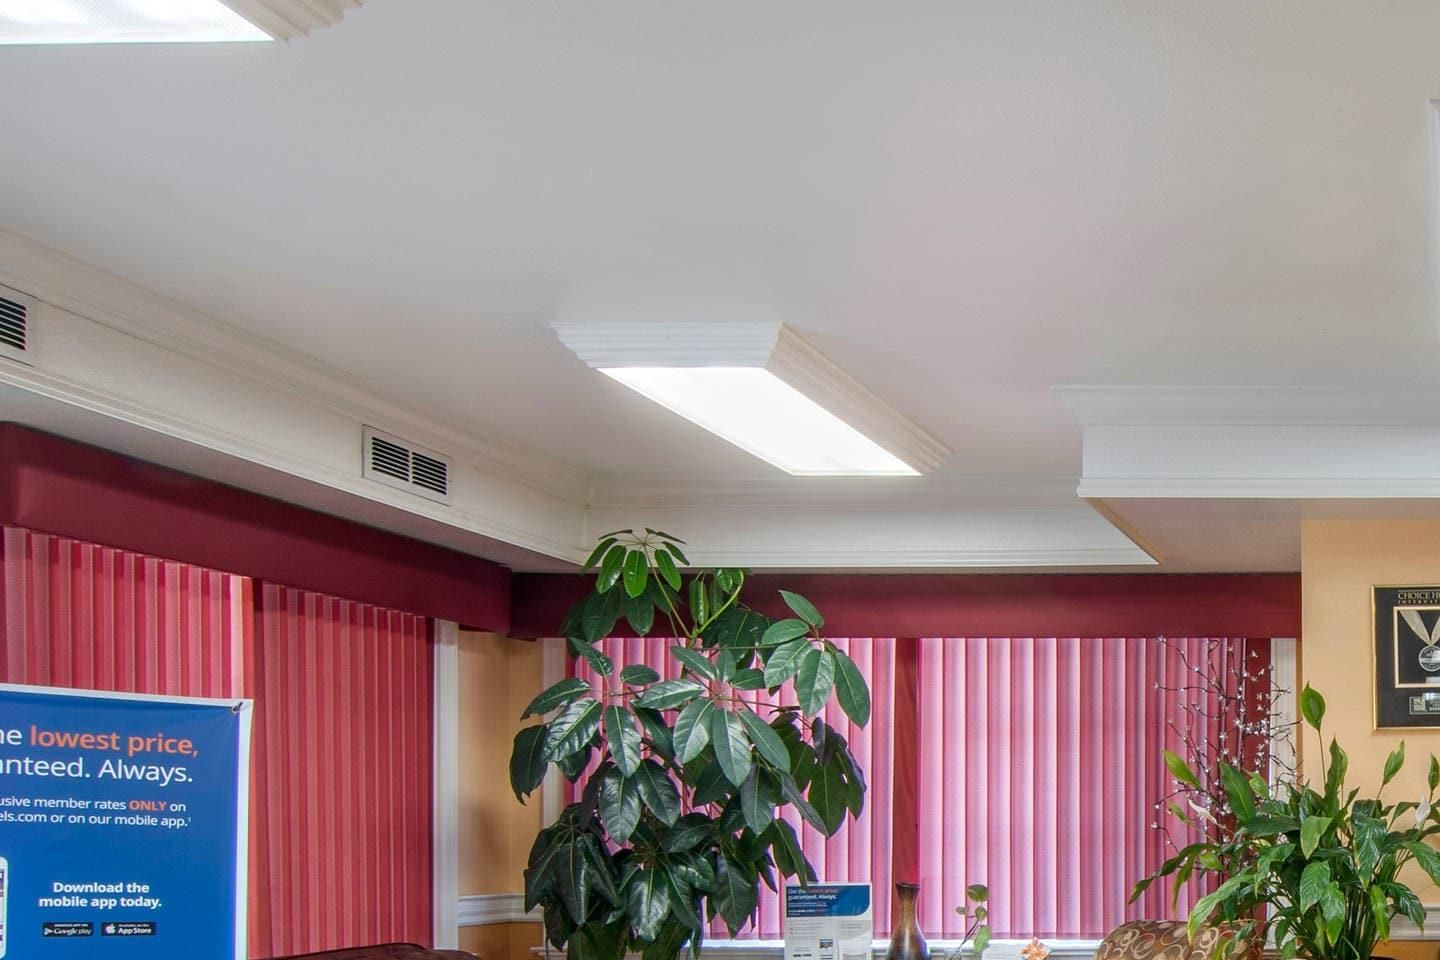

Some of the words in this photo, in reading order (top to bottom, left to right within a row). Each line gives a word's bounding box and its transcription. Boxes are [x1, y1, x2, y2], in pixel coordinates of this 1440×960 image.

[1398, 592, 1431, 600] CHOICE
[30, 725, 121, 751] lowest
[128, 733, 198, 758] price,
[0, 757, 91, 778] nteed.
[97, 758, 193, 787] Always.
[34, 798, 91, 809] member
[94, 800, 127, 810] rates
[129, 800, 167, 811] ONLY
[169, 803, 186, 812] on
[50, 814, 65, 823] or
[68, 814, 86, 824] on
[88, 815, 112, 825] our
[114, 814, 158, 826] mobile
[53, 881, 124, 893] Download
[126, 882, 150, 893] the
[38, 895, 88, 907] mobile
[90, 898, 117, 910] app
[120, 896, 163, 910] today.
[53, 927, 77, 936] Google
[78, 928, 92, 936] play
[118, 927, 132, 936] App
[133, 927, 152, 935] Store
